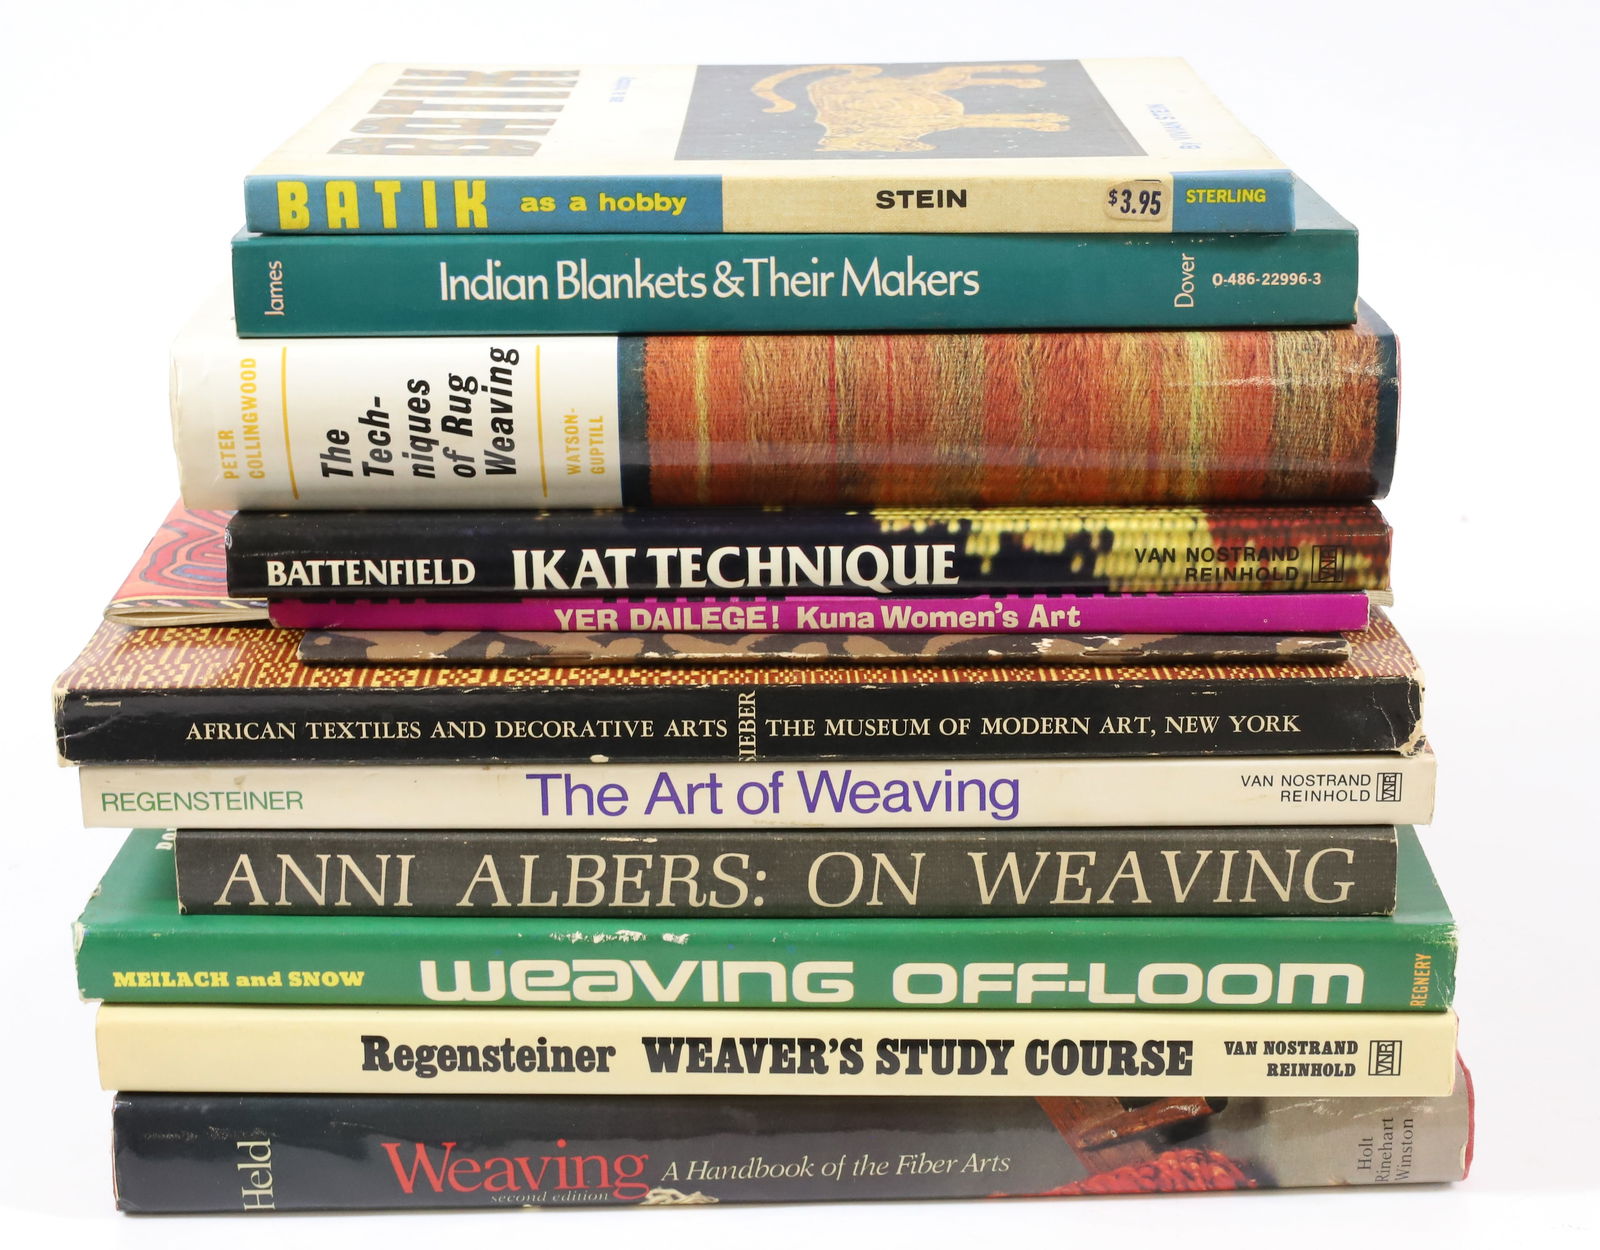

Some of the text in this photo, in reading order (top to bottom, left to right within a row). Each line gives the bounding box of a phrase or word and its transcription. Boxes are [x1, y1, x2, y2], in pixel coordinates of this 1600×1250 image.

[326, 68, 581, 157] BATIK
[276, 179, 489, 229] BATIK
[520, 193, 687, 216] as a hobby
[875, 188, 967, 209] STEIN
[1108, 188, 1161, 215] $3.95
[1186, 188, 1267, 203] STERLING
[264, 260, 284, 316] James
[440, 259, 548, 301] Indian
[557, 257, 706, 299] Blankets
[841, 255, 980, 297] Makers
[1173, 253, 1195, 308] Dover
[1212, 272, 1322, 286] 0-486-22996-3
[240, 357, 266, 479] COLLINGWOOD
[402, 378, 439, 478] niques
[442, 373, 478, 478] of Rug
[481, 346, 519, 475] Weaving
[218, 429, 240, 480] PETER
[320, 428, 354, 478] The
[358, 396, 395, 478] Tech-
[567, 408, 581, 475] WATSON-
[591, 415, 606, 475] GUPTILL
[266, 559, 476, 587] BATTENFIELD
[512, 544, 960, 594] IKAT TECHNIQUE
[1134, 546, 1299, 563] VAN NOSTRAND
[1185, 566, 1299, 582] REINHOLD
[553, 602, 1081, 631] YER DAILEGE! Kuna Women's Art
[186, 718, 728, 741] AFRICAN TEXTILES AND DECORATIVE ARTS
[765, 714, 1301, 738] THE MUSEUM OF MODERN ART, NEW YORK
[101, 791, 303, 812] REGENSTEINER
[526, 770, 1020, 820] The Art of Weaving
[1241, 774, 1371, 788] VAN NOSTRAND
[1280, 789, 1371, 802] REINHOLD
[214, 848, 1355, 908] ANNI ALBERS: ON WEAVING
[112, 971, 365, 988] MEILACH and SNOW
[1410, 953, 1431, 1007] REGNERY
[361, 1035, 1193, 1079] Regensteiner WEAVER'S STUDY COURSE
[1224, 1040, 1358, 1056] VAN NOSTRAND
[1266, 1062, 1356, 1077] REINHOLD
[1377, 1041, 1393, 1075] VNR
[381, 1138, 649, 1199] Weaving
[661, 1153, 1010, 1184] A Handbook of the Fiber Arts
[1357, 1137, 1374, 1171] Holt
[1375, 1117, 1393, 1183] Rinehart
[1395, 1118, 1414, 1182] Winston
[236, 1137, 275, 1211] Held
[491, 1190, 608, 1203] second edition
